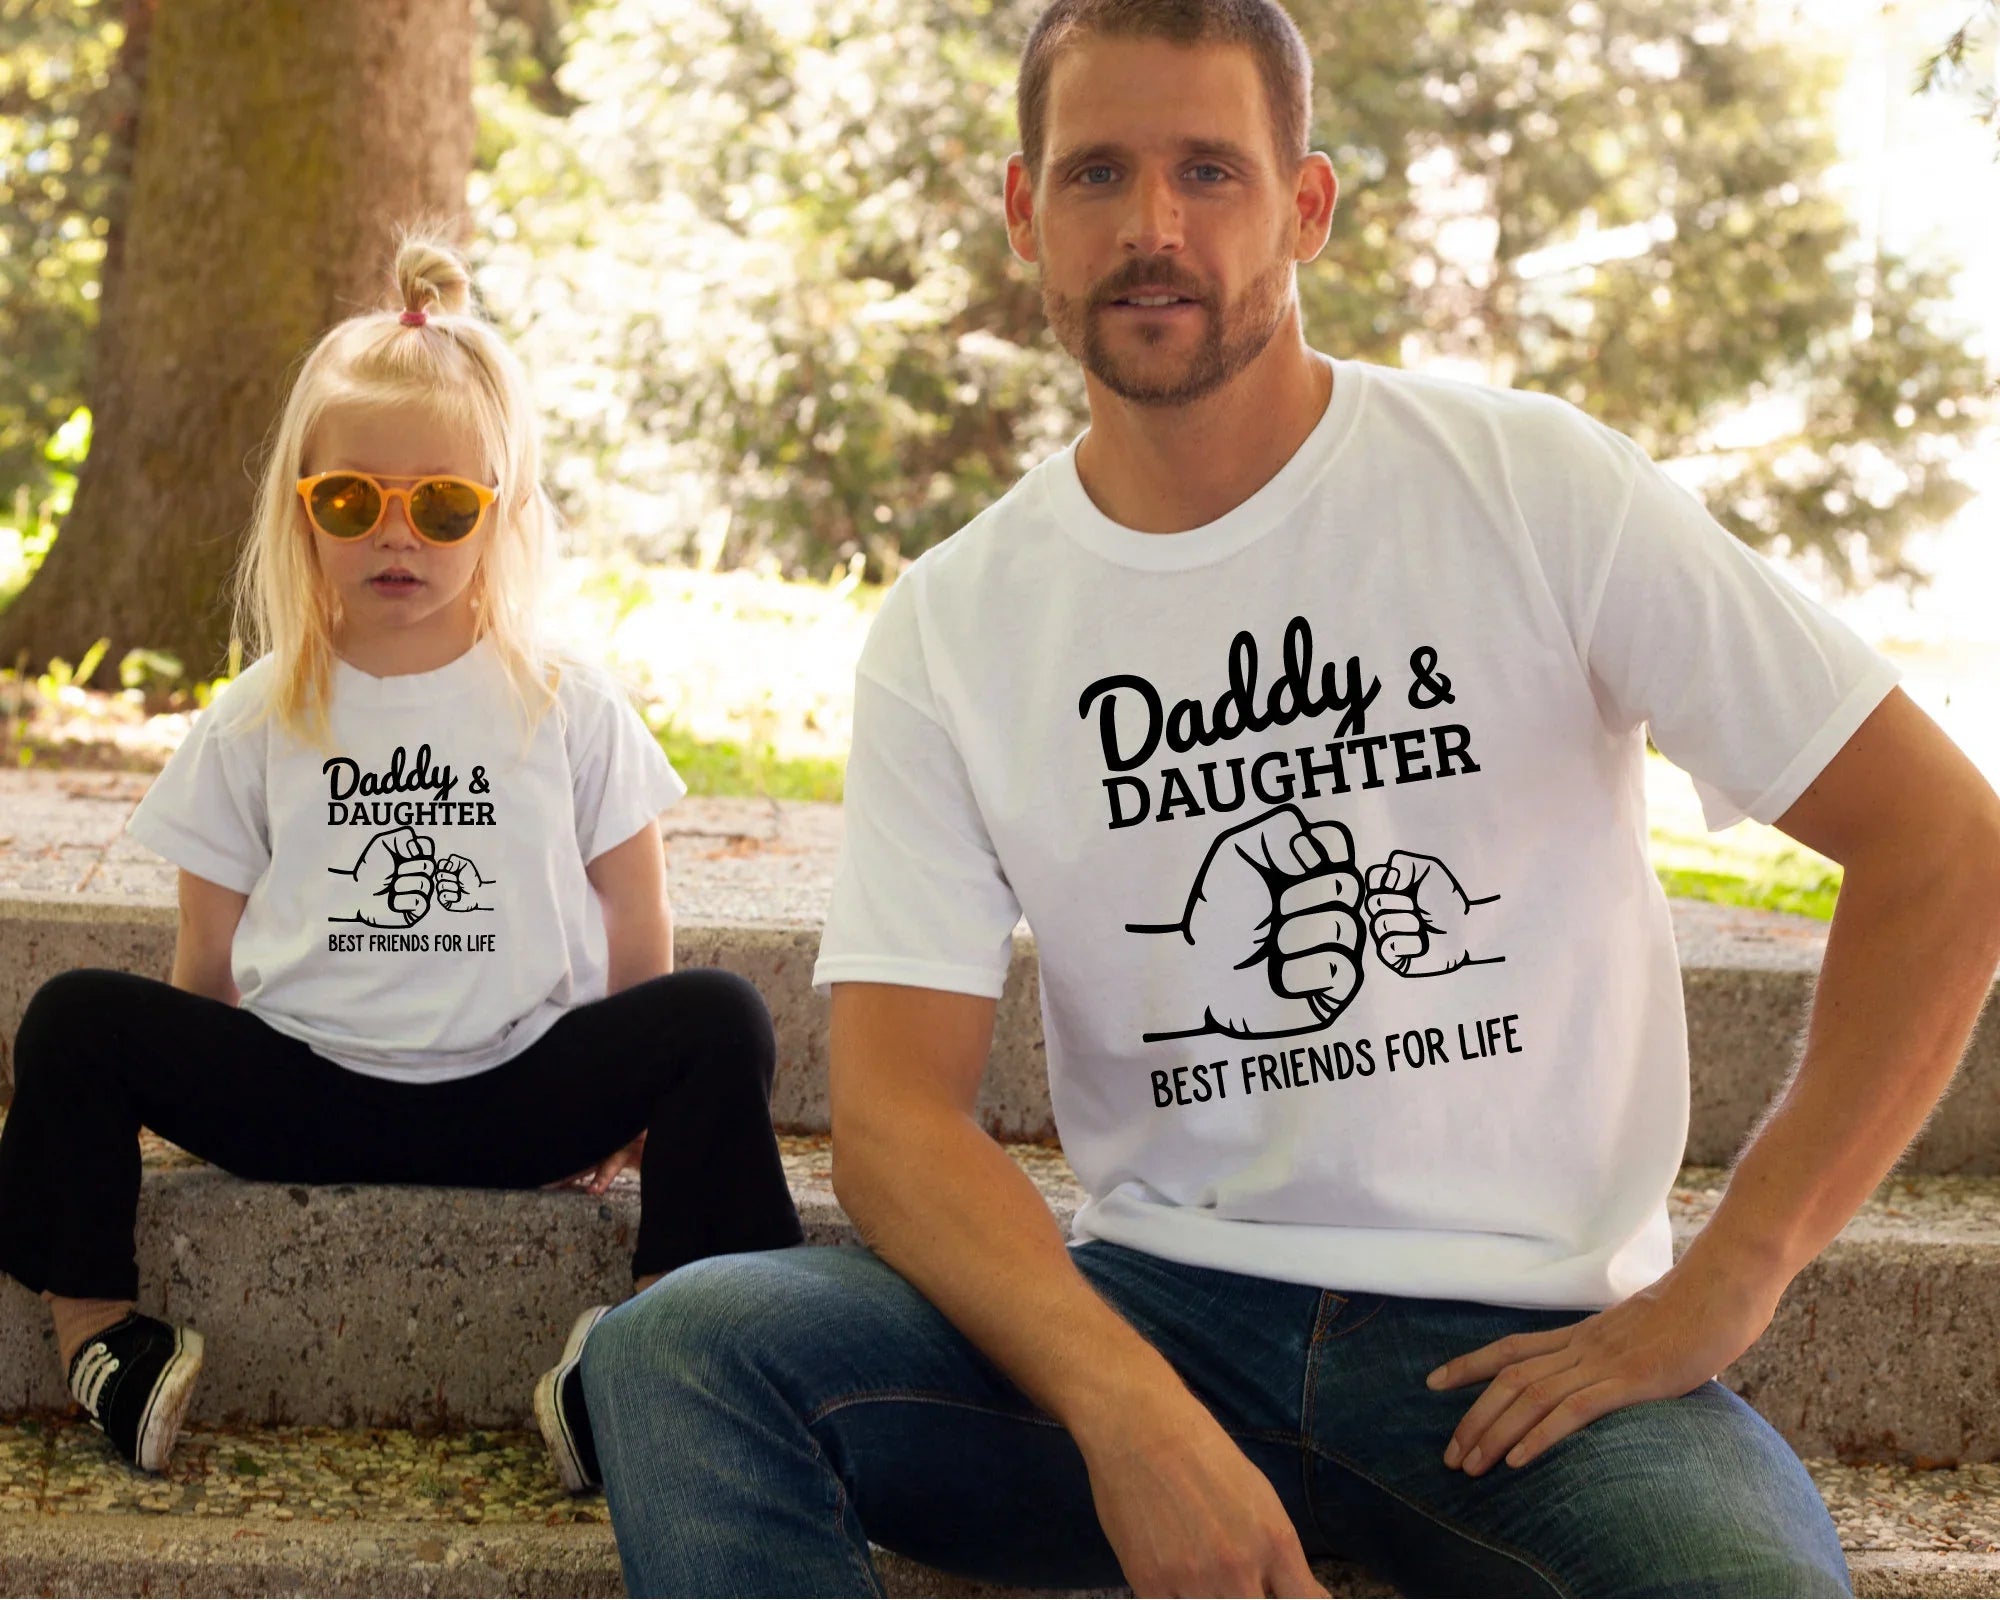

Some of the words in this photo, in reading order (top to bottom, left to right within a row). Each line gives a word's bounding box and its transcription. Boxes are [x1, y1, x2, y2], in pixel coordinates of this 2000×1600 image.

[1078, 615, 1382, 772] Daddy
[1407, 645, 1456, 710] &
[322, 743, 459, 802] Daddy
[468, 765, 491, 795] &
[1101, 723, 1482, 830] DAUGHTER
[327, 801, 497, 826] DAUGHTER
[328, 933, 365, 952] BEST
[369, 933, 430, 952] FRIENDS
[434, 933, 463, 952] FOR
[467, 933, 496, 952] LIFE
[1150, 1059, 1229, 1109] BEST
[1240, 1038, 1377, 1095] FRIENDS
[1384, 1027, 1450, 1073] FOR
[1457, 1013, 1523, 1061] LIFE
